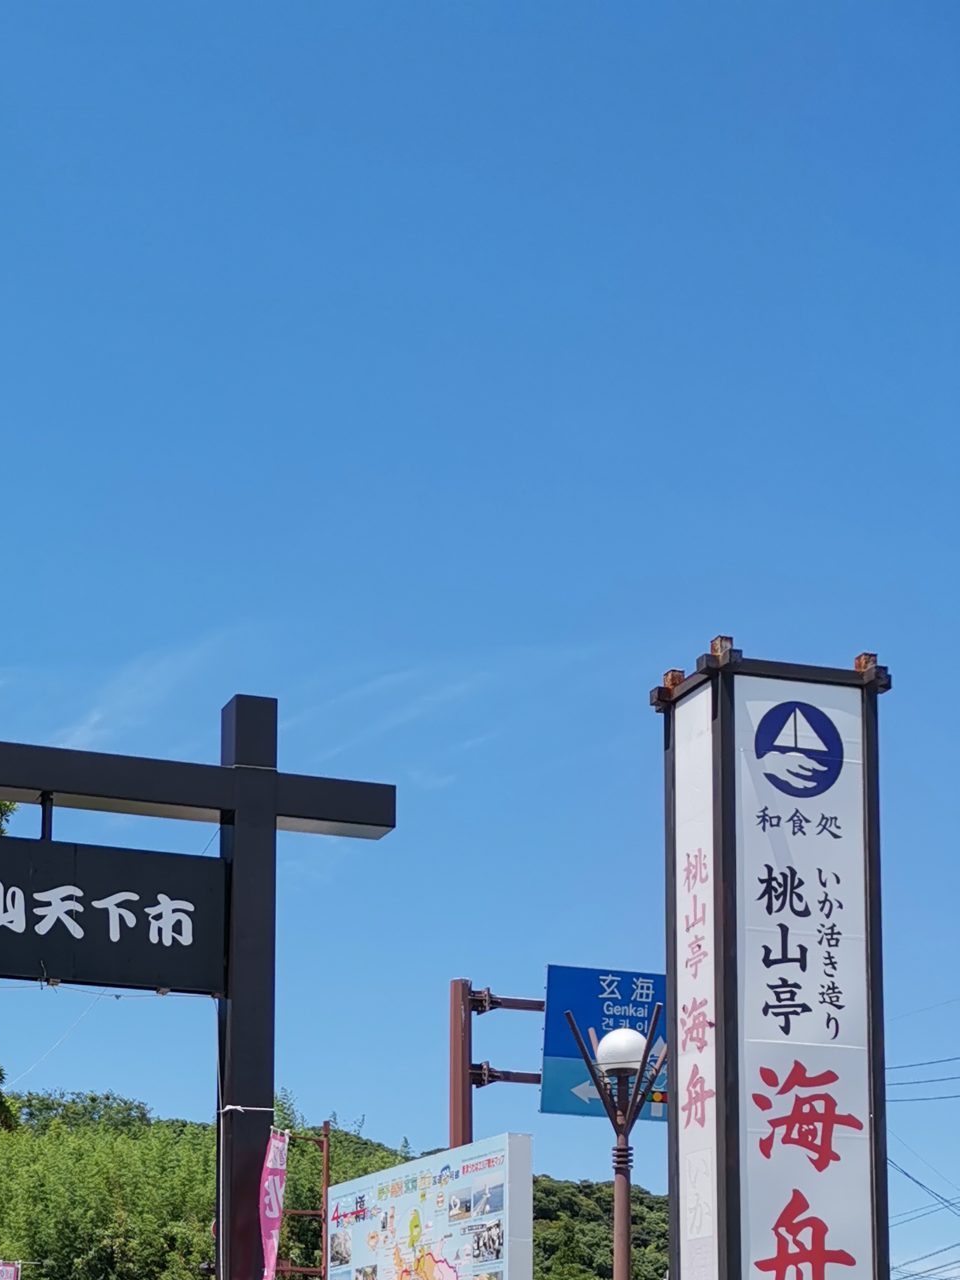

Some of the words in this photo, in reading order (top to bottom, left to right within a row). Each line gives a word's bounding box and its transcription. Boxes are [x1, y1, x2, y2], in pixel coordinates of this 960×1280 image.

[755, 806, 844, 840] 和食処
[682, 847, 710, 981] 桃山亭
[755, 863, 813, 1037] 桃山亭
[816, 867, 846, 1041] いか活き造り
[598, 974, 655, 1003] 玄海
[603, 1001, 649, 1018] Genkai
[681, 996, 716, 1131] 海舟
